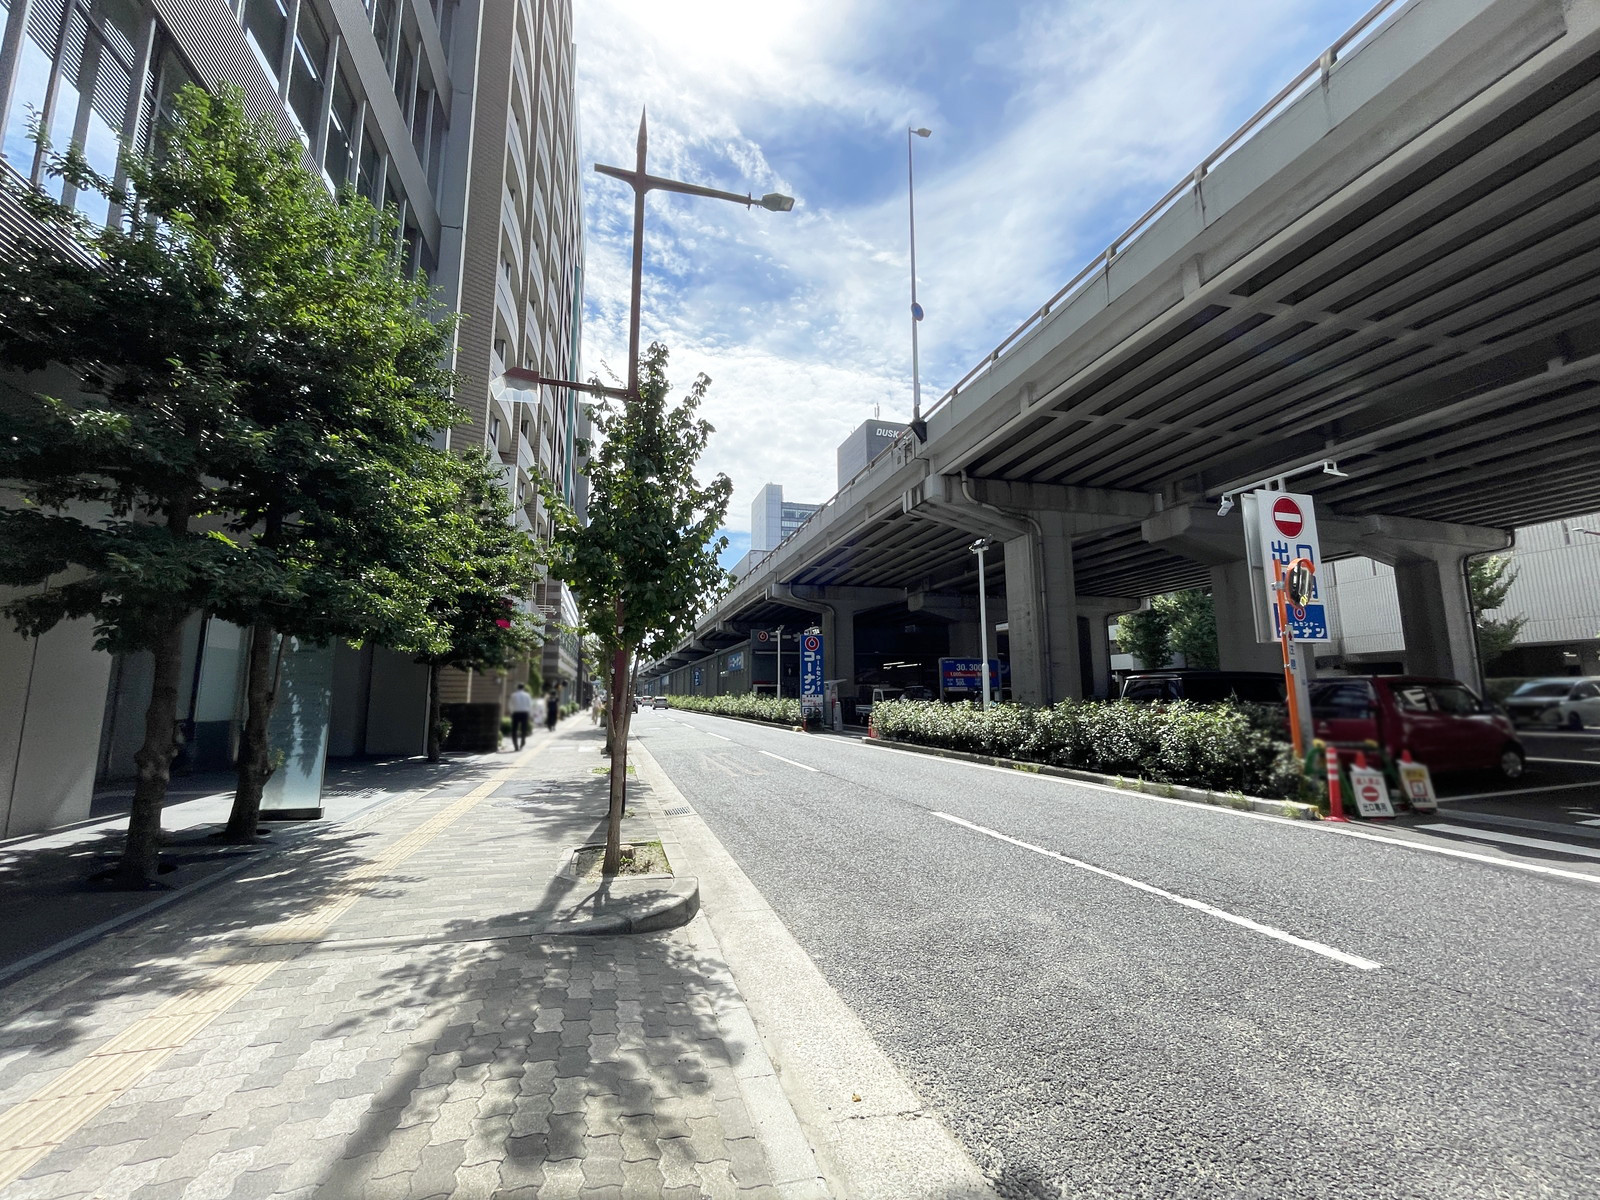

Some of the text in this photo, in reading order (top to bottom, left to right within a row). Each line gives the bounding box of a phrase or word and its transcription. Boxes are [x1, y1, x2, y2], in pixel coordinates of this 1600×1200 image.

[1271, 540, 1314, 566] 出口
[804, 651, 816, 695] コーナン
